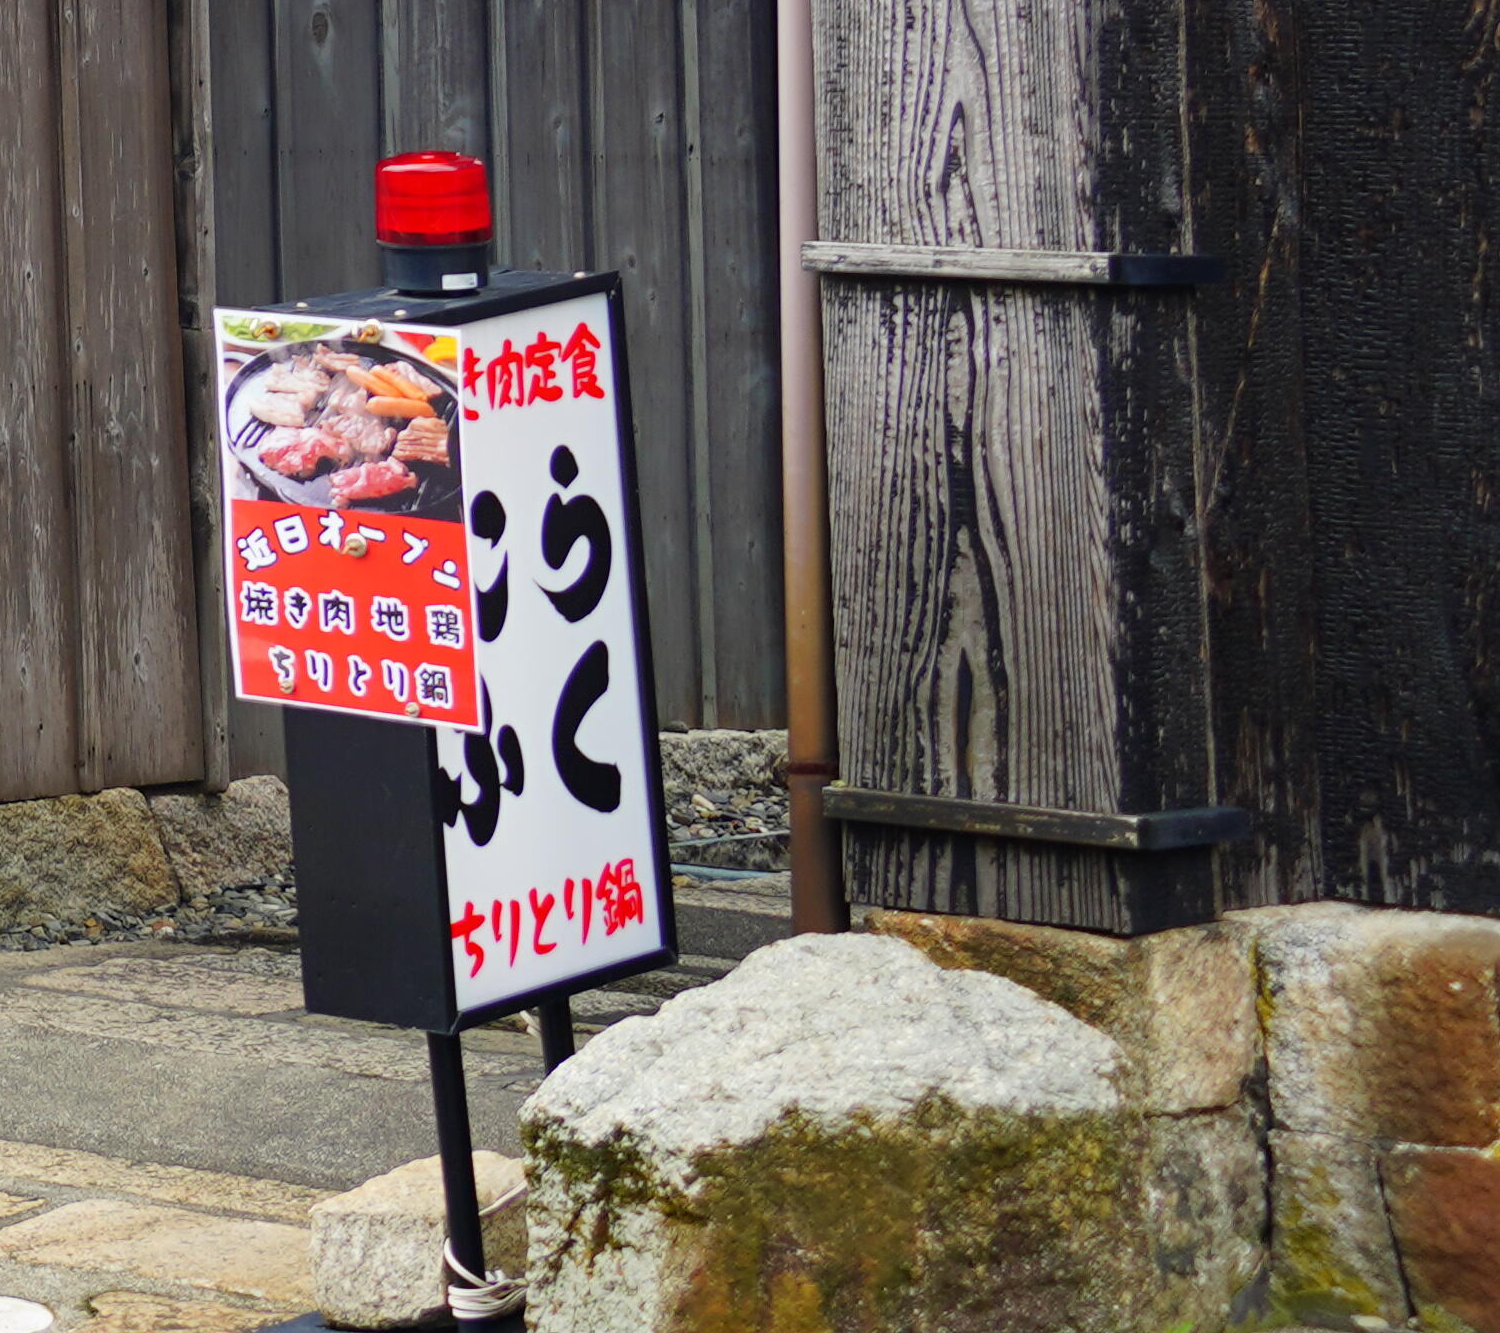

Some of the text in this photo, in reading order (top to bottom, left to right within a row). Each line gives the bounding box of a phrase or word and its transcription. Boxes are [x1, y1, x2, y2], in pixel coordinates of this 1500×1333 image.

[236, 509, 462, 591] 近日オープン
[268, 645, 454, 710] ちりとり鍋
[533, 445, 621, 813] らく
[451, 858, 645, 981] ちりとり鍋
